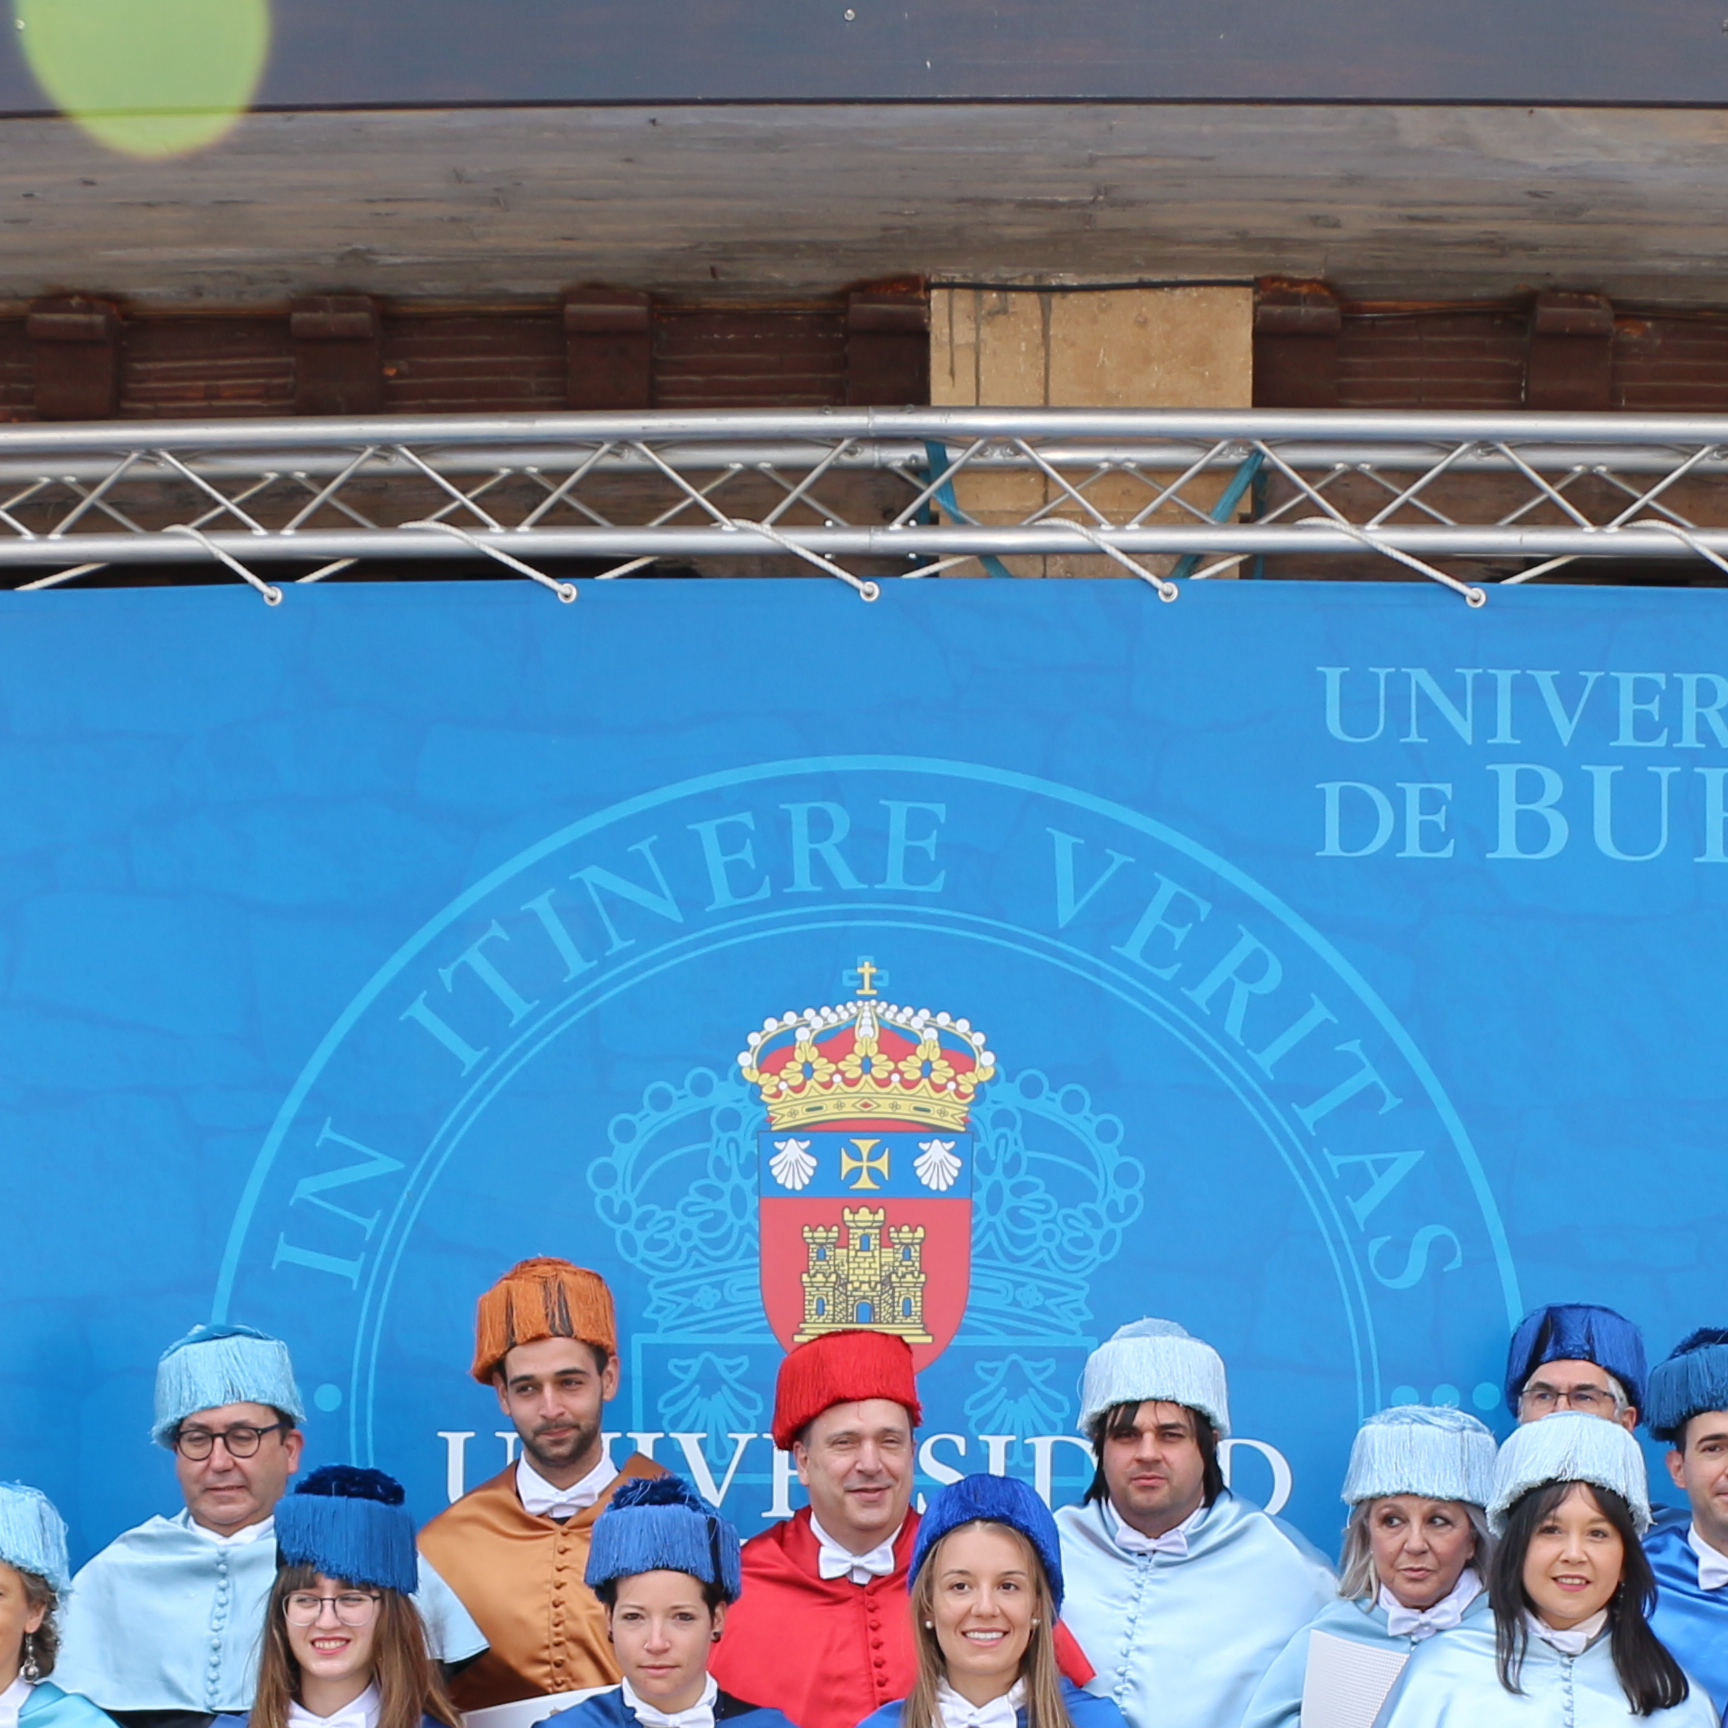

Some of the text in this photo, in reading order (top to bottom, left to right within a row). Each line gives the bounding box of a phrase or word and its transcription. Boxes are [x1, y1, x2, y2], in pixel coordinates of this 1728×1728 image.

[1314, 780, 1456, 860] DE
[271, 799, 1464, 1292] IN ITINERE VERITAS
